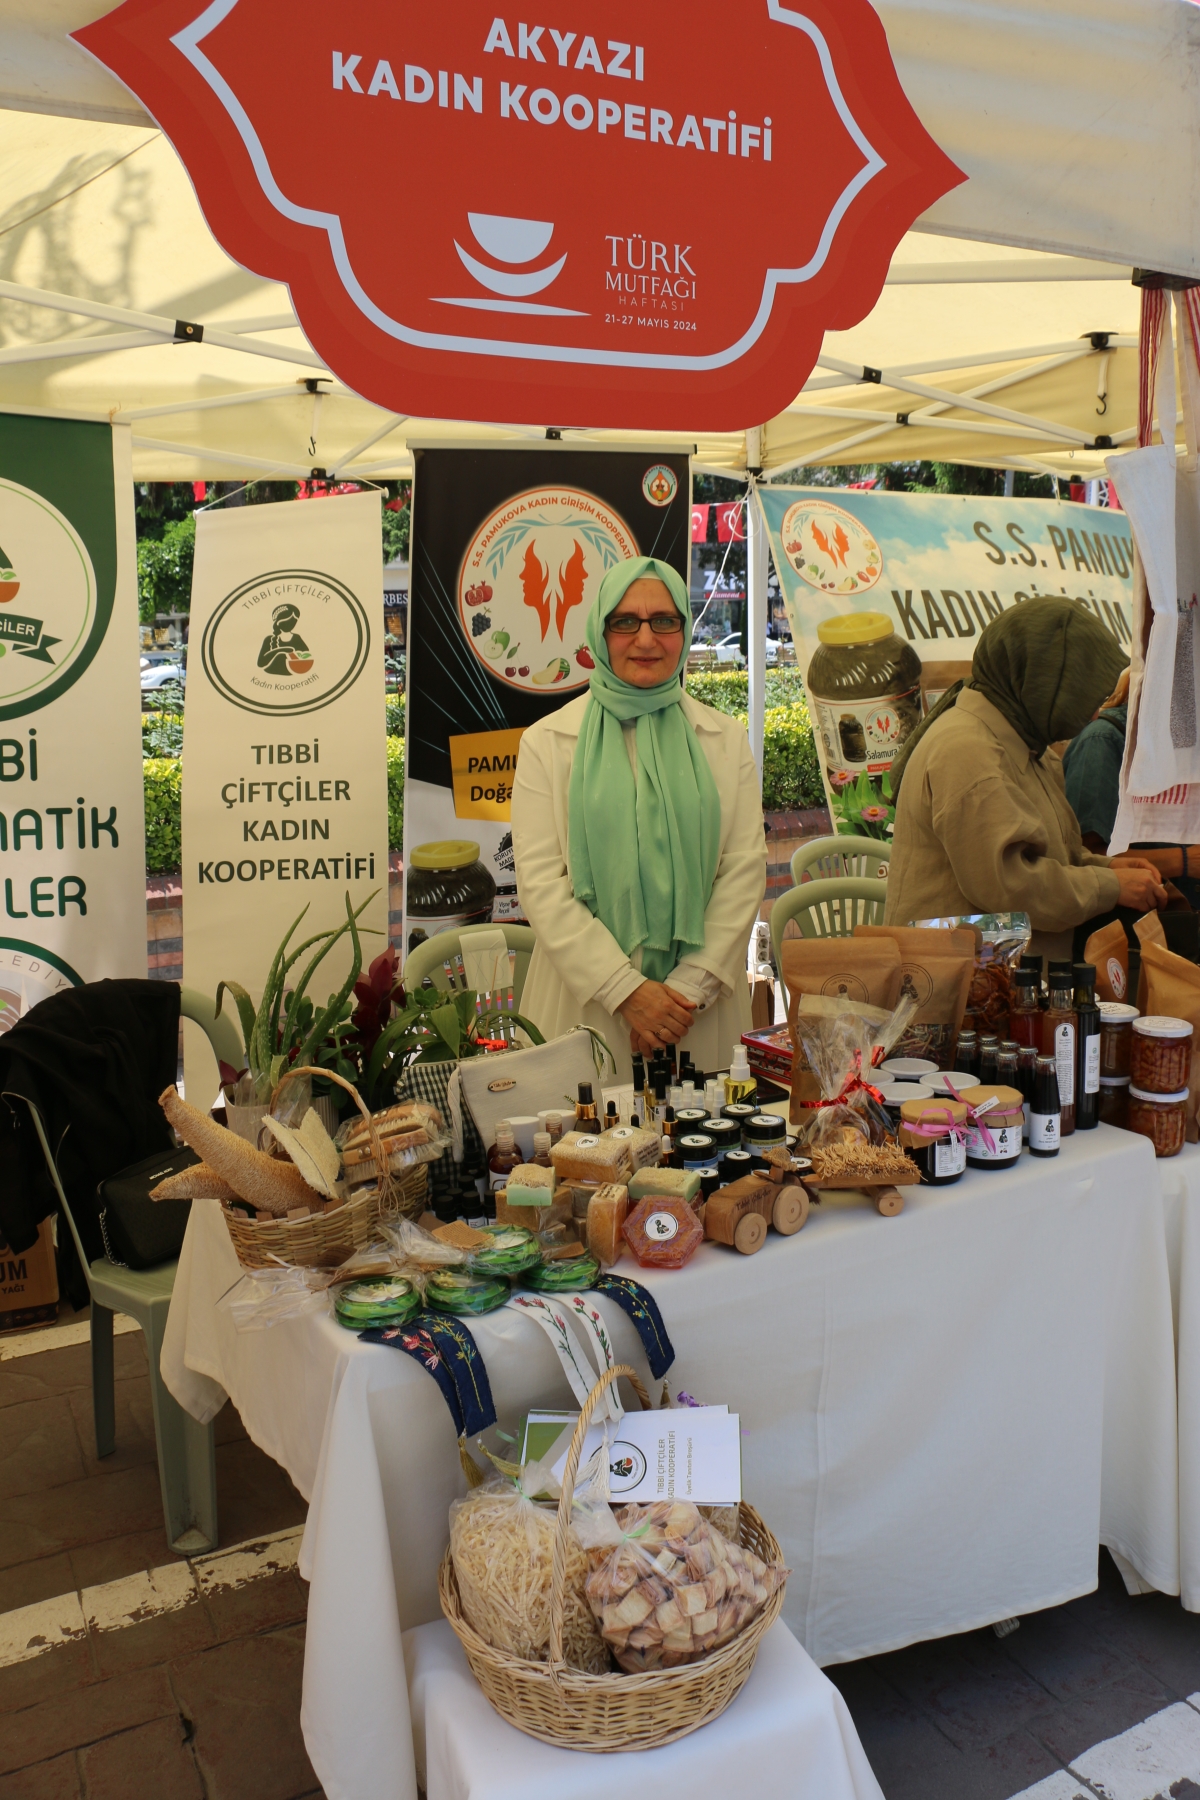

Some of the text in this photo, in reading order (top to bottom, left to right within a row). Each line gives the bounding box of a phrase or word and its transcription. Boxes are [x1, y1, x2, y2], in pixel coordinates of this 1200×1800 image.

[483, 17, 644, 81] AKYAZI
[332, 50, 772, 161] KADIN KOOPERATİFİ
[605, 233, 697, 276] TÜRK
[605, 271, 697, 299] MUTFAĞI
[618, 295, 684, 311] HAFTASI
[604, 313, 697, 331] 21-27 MAYIS 2024
[472, 549, 486, 568] S.S.
[480, 503, 527, 549] PAMUKOVA
[527, 496, 559, 510] KADIN
[560, 495, 596, 515] GİRİŞİM
[972, 520, 1048, 568] S.S.
[241, 583, 332, 611] TIBBİ ÇİFTÇİLER
[250, 673, 320, 691] Kadın Kooperatifi
[250, 738, 319, 765] TIBBİ
[866, 749, 898, 760] Salamura
[221, 775, 351, 809] ÇİFTÇİLER
[0, 797, 119, 851] ATİK
[243, 818, 330, 842] KADIN
[198, 852, 375, 884] KOOPERATİFİ
[667, 1430, 676, 1477] KOOPERATİFİ
